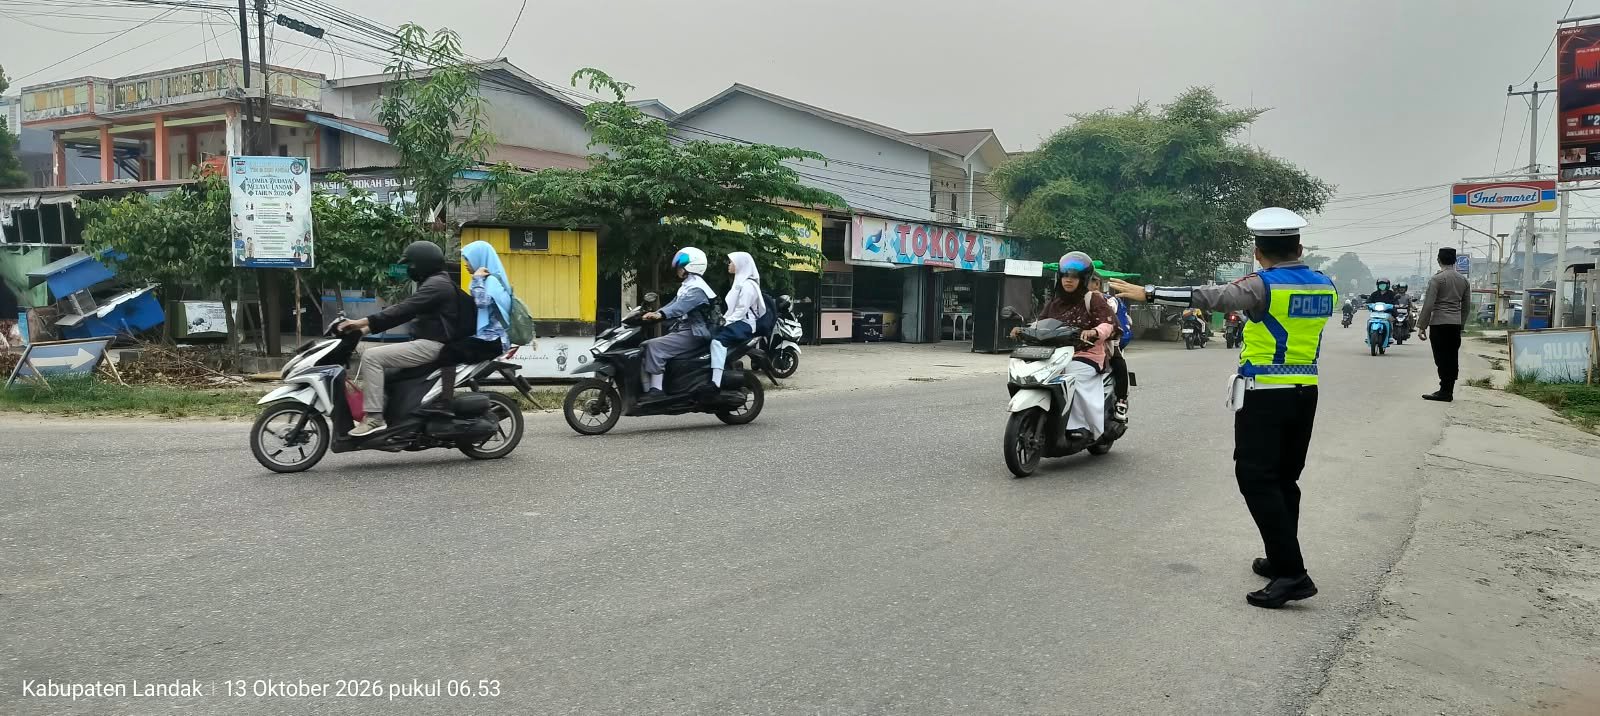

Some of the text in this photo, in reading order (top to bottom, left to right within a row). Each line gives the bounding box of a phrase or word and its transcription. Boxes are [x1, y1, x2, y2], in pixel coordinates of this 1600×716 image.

[1470, 191, 1537, 204] Indomaret
[896, 223, 960, 260] TOKO
[964, 234, 978, 263] Z
[1291, 295, 1332, 314] POLISI
